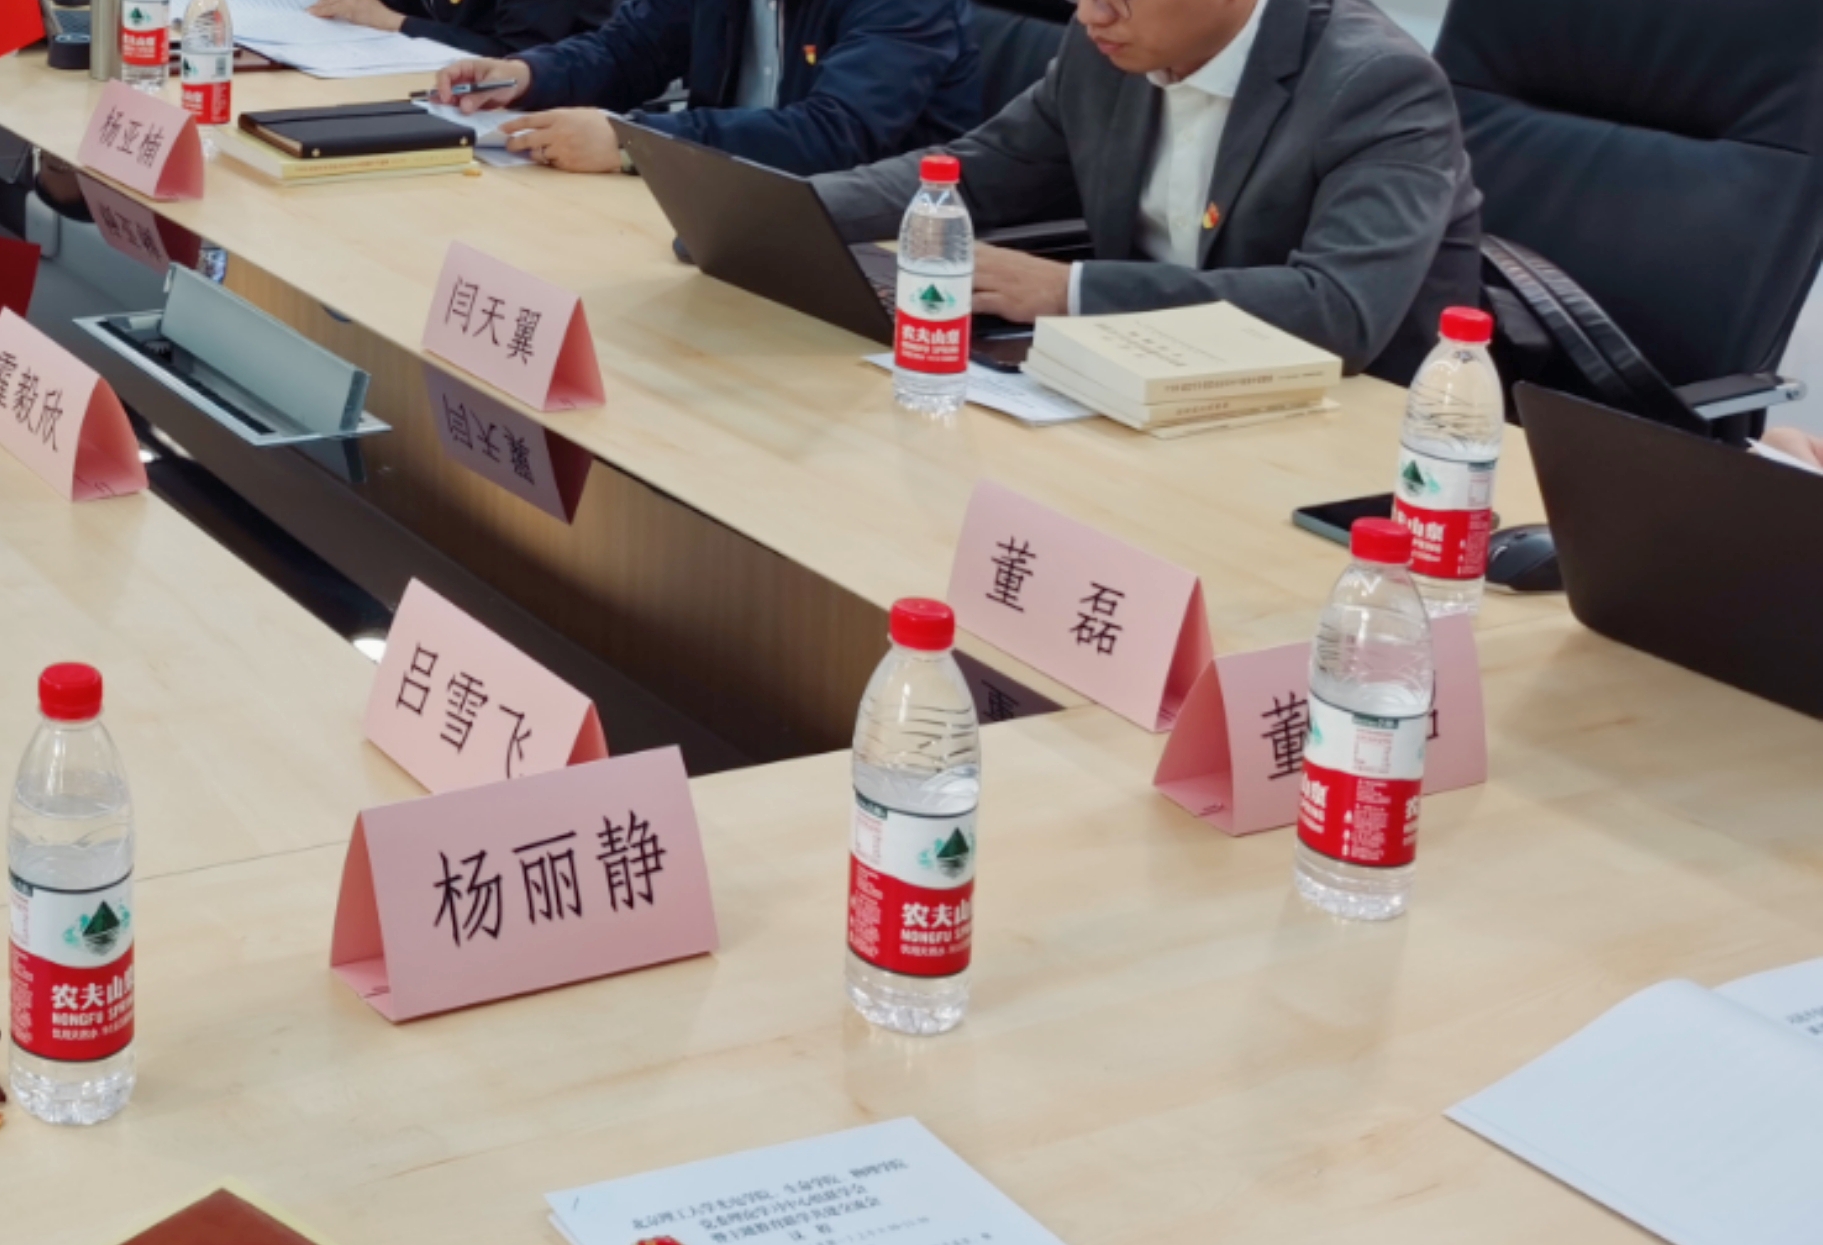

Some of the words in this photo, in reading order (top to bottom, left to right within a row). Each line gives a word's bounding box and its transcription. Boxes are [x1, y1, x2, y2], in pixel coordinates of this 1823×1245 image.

[443, 273, 543, 365] 闫天翼
[984, 535, 1125, 657] 董磊
[394, 641, 534, 779] 吕雪飞
[433, 809, 669, 949] 杨丽静
